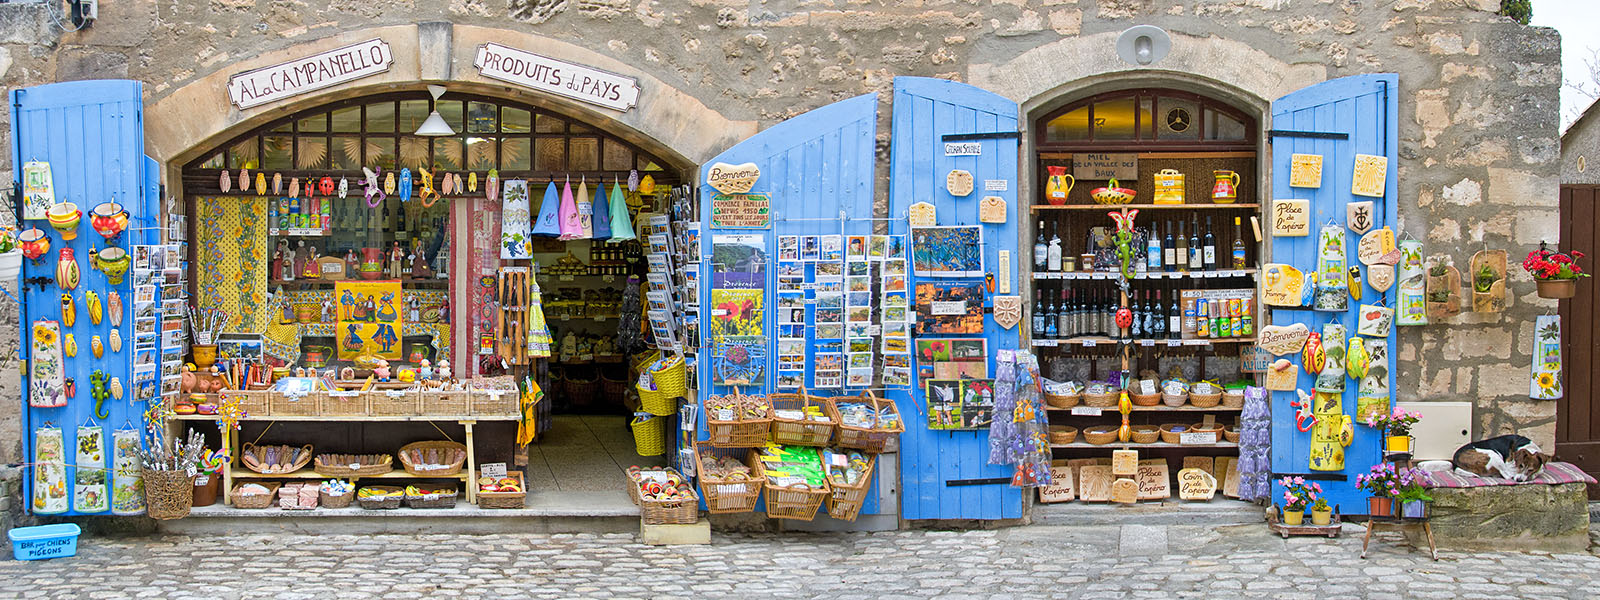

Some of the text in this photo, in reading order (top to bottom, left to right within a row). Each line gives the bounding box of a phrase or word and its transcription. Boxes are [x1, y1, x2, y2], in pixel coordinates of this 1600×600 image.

[270, 45, 384, 92] CAMPANELLO
[483, 52, 621, 101] PRODUITS du PAYS
[710, 168, 760, 181] Bienvenue
[1276, 202, 1302, 217] Place
[723, 280, 756, 288] Provence
[721, 290, 755, 298] Provence
[1264, 289, 1287, 301] Fanny
[1262, 330, 1309, 344] Bienvenue
[1051, 469, 1067, 479] lace
[1137, 467, 1162, 480] Place
[1183, 472, 1202, 480] Coin
[46, 539, 71, 547] CHIENS
[29, 547, 62, 556] PIGEONS
